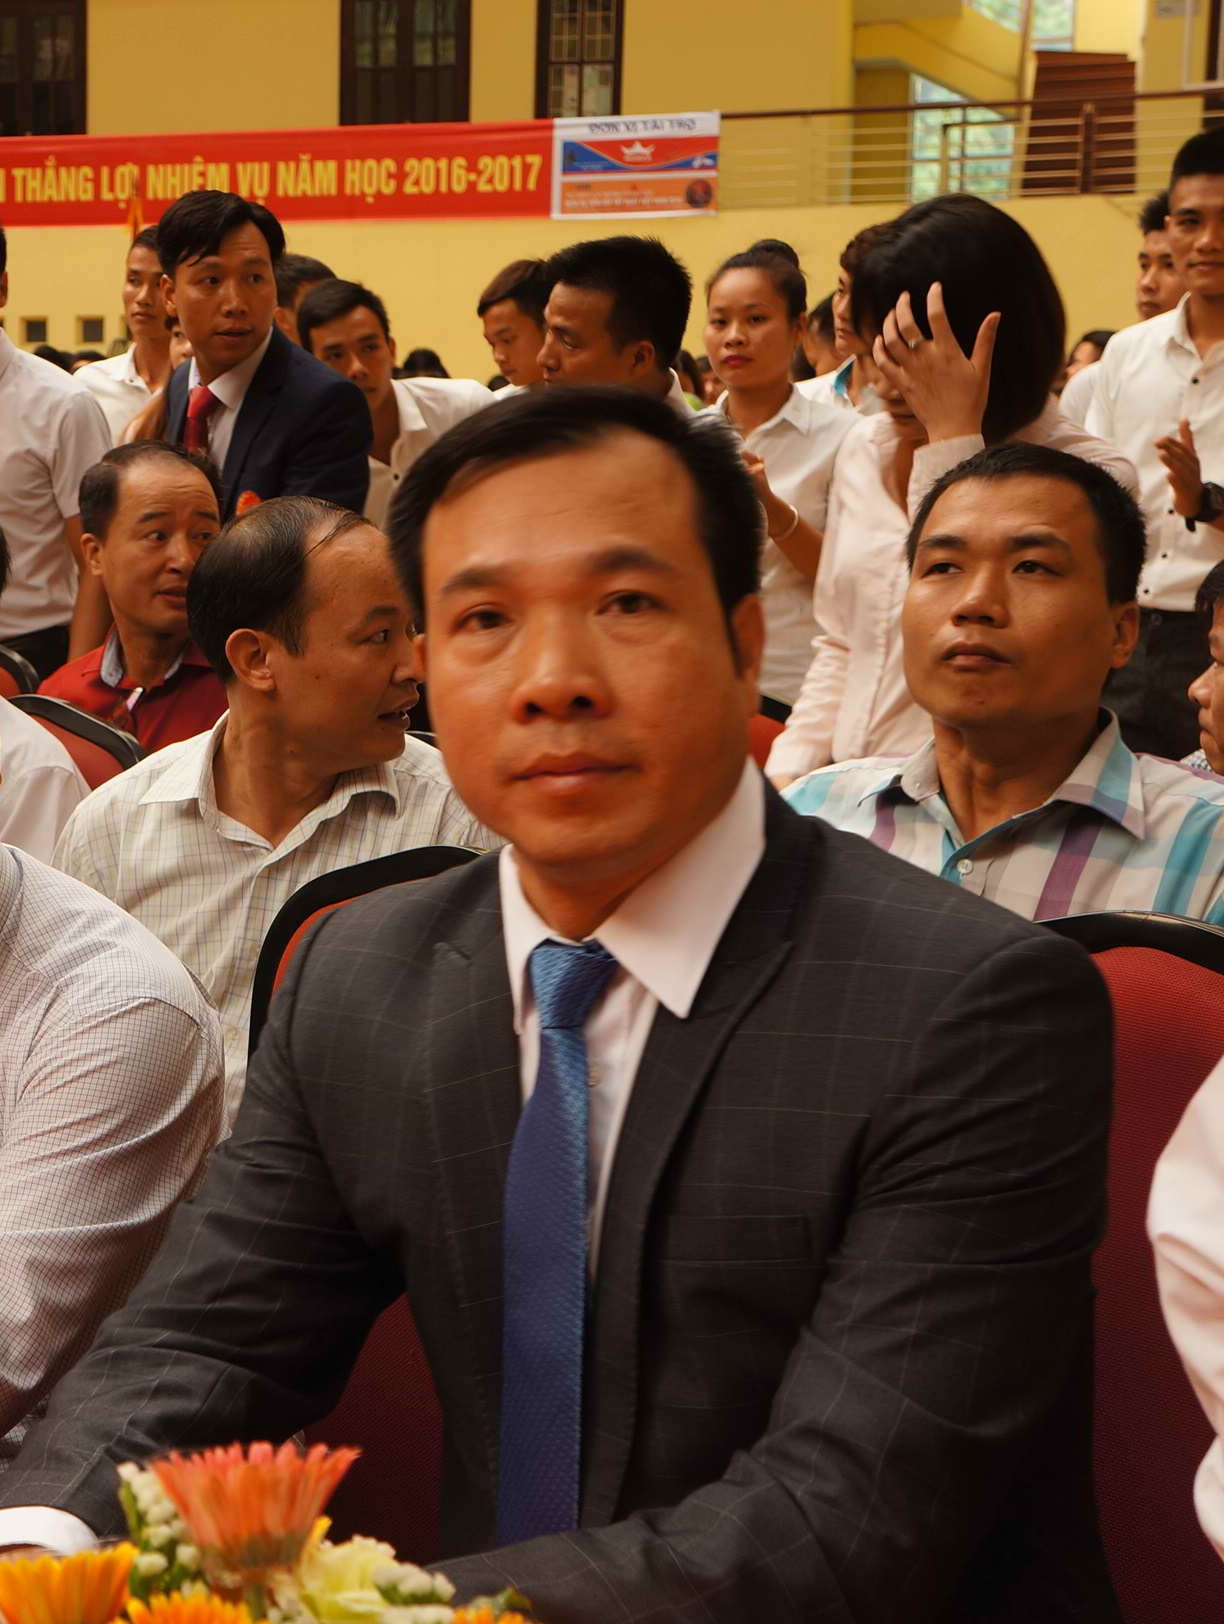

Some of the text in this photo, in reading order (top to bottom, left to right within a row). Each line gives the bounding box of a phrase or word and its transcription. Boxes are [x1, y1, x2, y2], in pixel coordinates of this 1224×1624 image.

[11, 154, 95, 203] THẮNG
[236, 161, 270, 206] VỤ
[277, 153, 338, 197] NĂM
[343, 157, 397, 204] HỌC
[403, 153, 543, 195] 2016-2017
